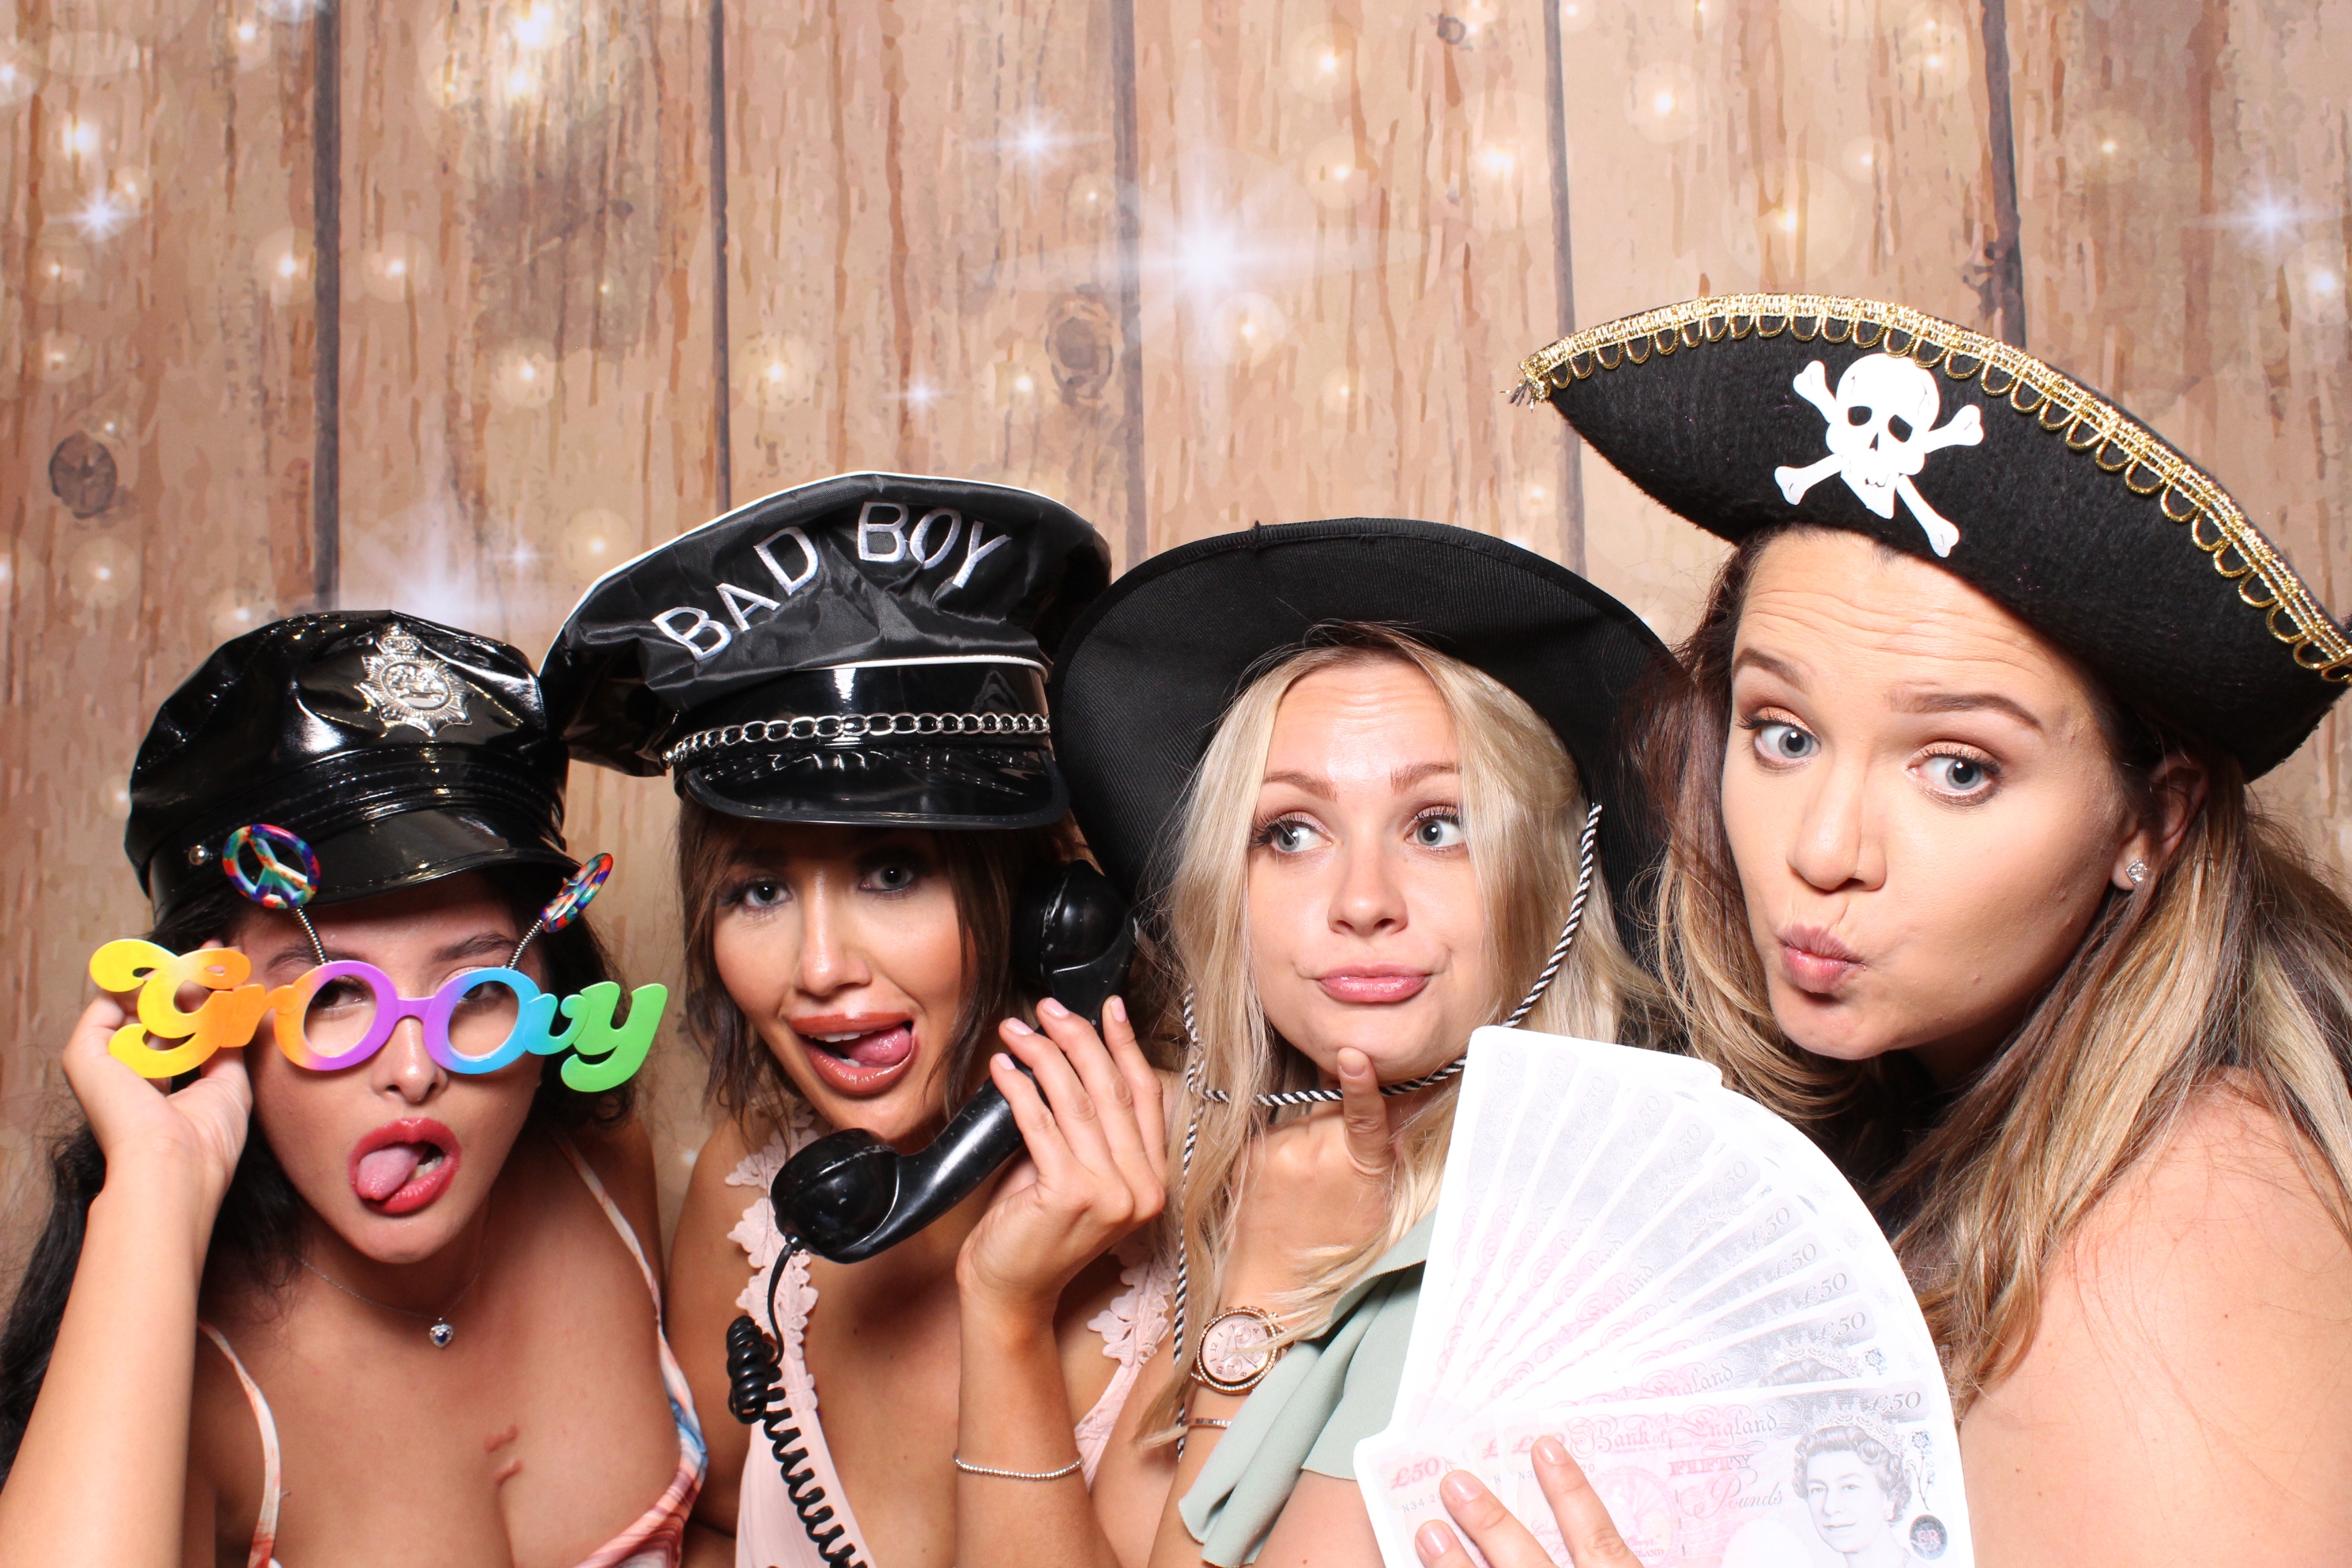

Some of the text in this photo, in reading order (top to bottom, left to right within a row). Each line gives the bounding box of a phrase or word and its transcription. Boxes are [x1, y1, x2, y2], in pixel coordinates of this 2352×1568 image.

[652, 502, 1011, 662] BAD BOY
[1669, 1123, 1701, 1167] £50
[1710, 1160, 1748, 1203] £50
[1749, 1207, 1791, 1248] £50
[1773, 1243, 1818, 1279] £50
[1801, 1272, 1848, 1306] £50
[1818, 1311, 1867, 1341] £50
[1868, 1390, 1922, 1413] £50
[1567, 1405, 1782, 1459] Bank of England
[1390, 1458, 1440, 1490] £50
[1668, 1454, 1754, 1476] FIFTY
[1403, 1498, 1424, 1514] N34
[1680, 1469, 1782, 1519] Pounds
